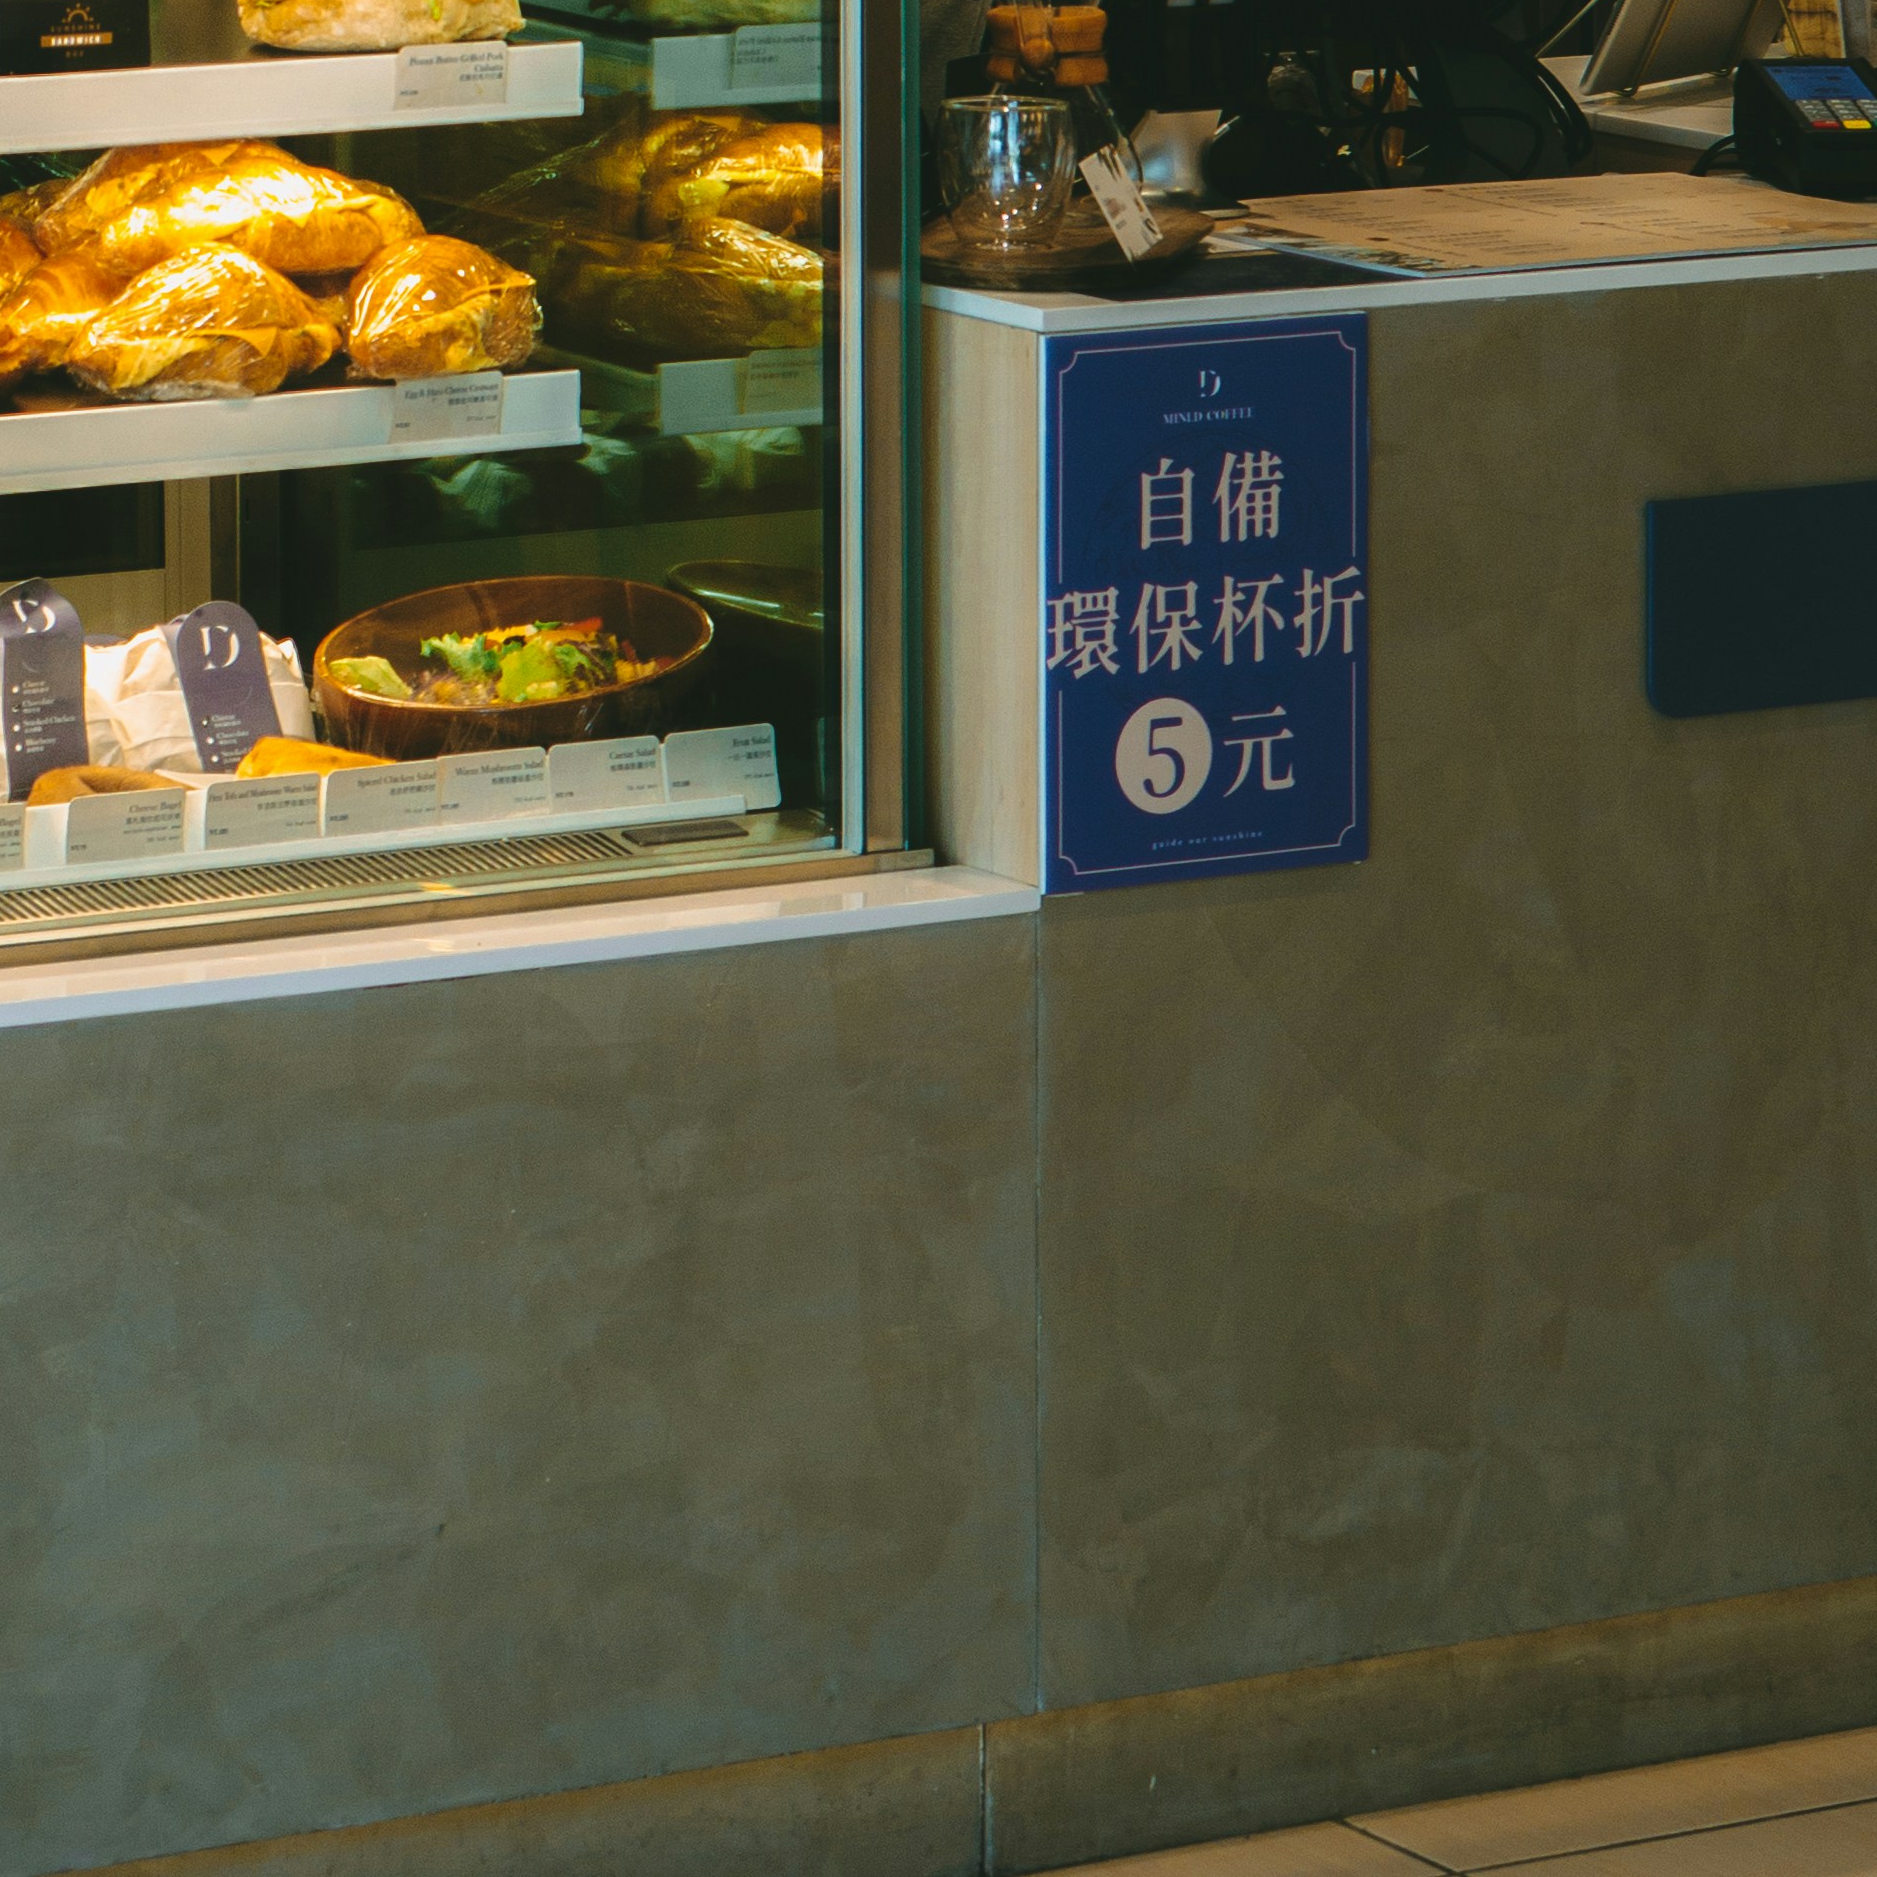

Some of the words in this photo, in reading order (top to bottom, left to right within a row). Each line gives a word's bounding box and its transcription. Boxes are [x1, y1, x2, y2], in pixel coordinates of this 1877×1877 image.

[1206, 407, 1254, 422] COFFEE
[1140, 450, 1284, 550] 自備
[1046, 566, 1365, 679] 環保杯折
